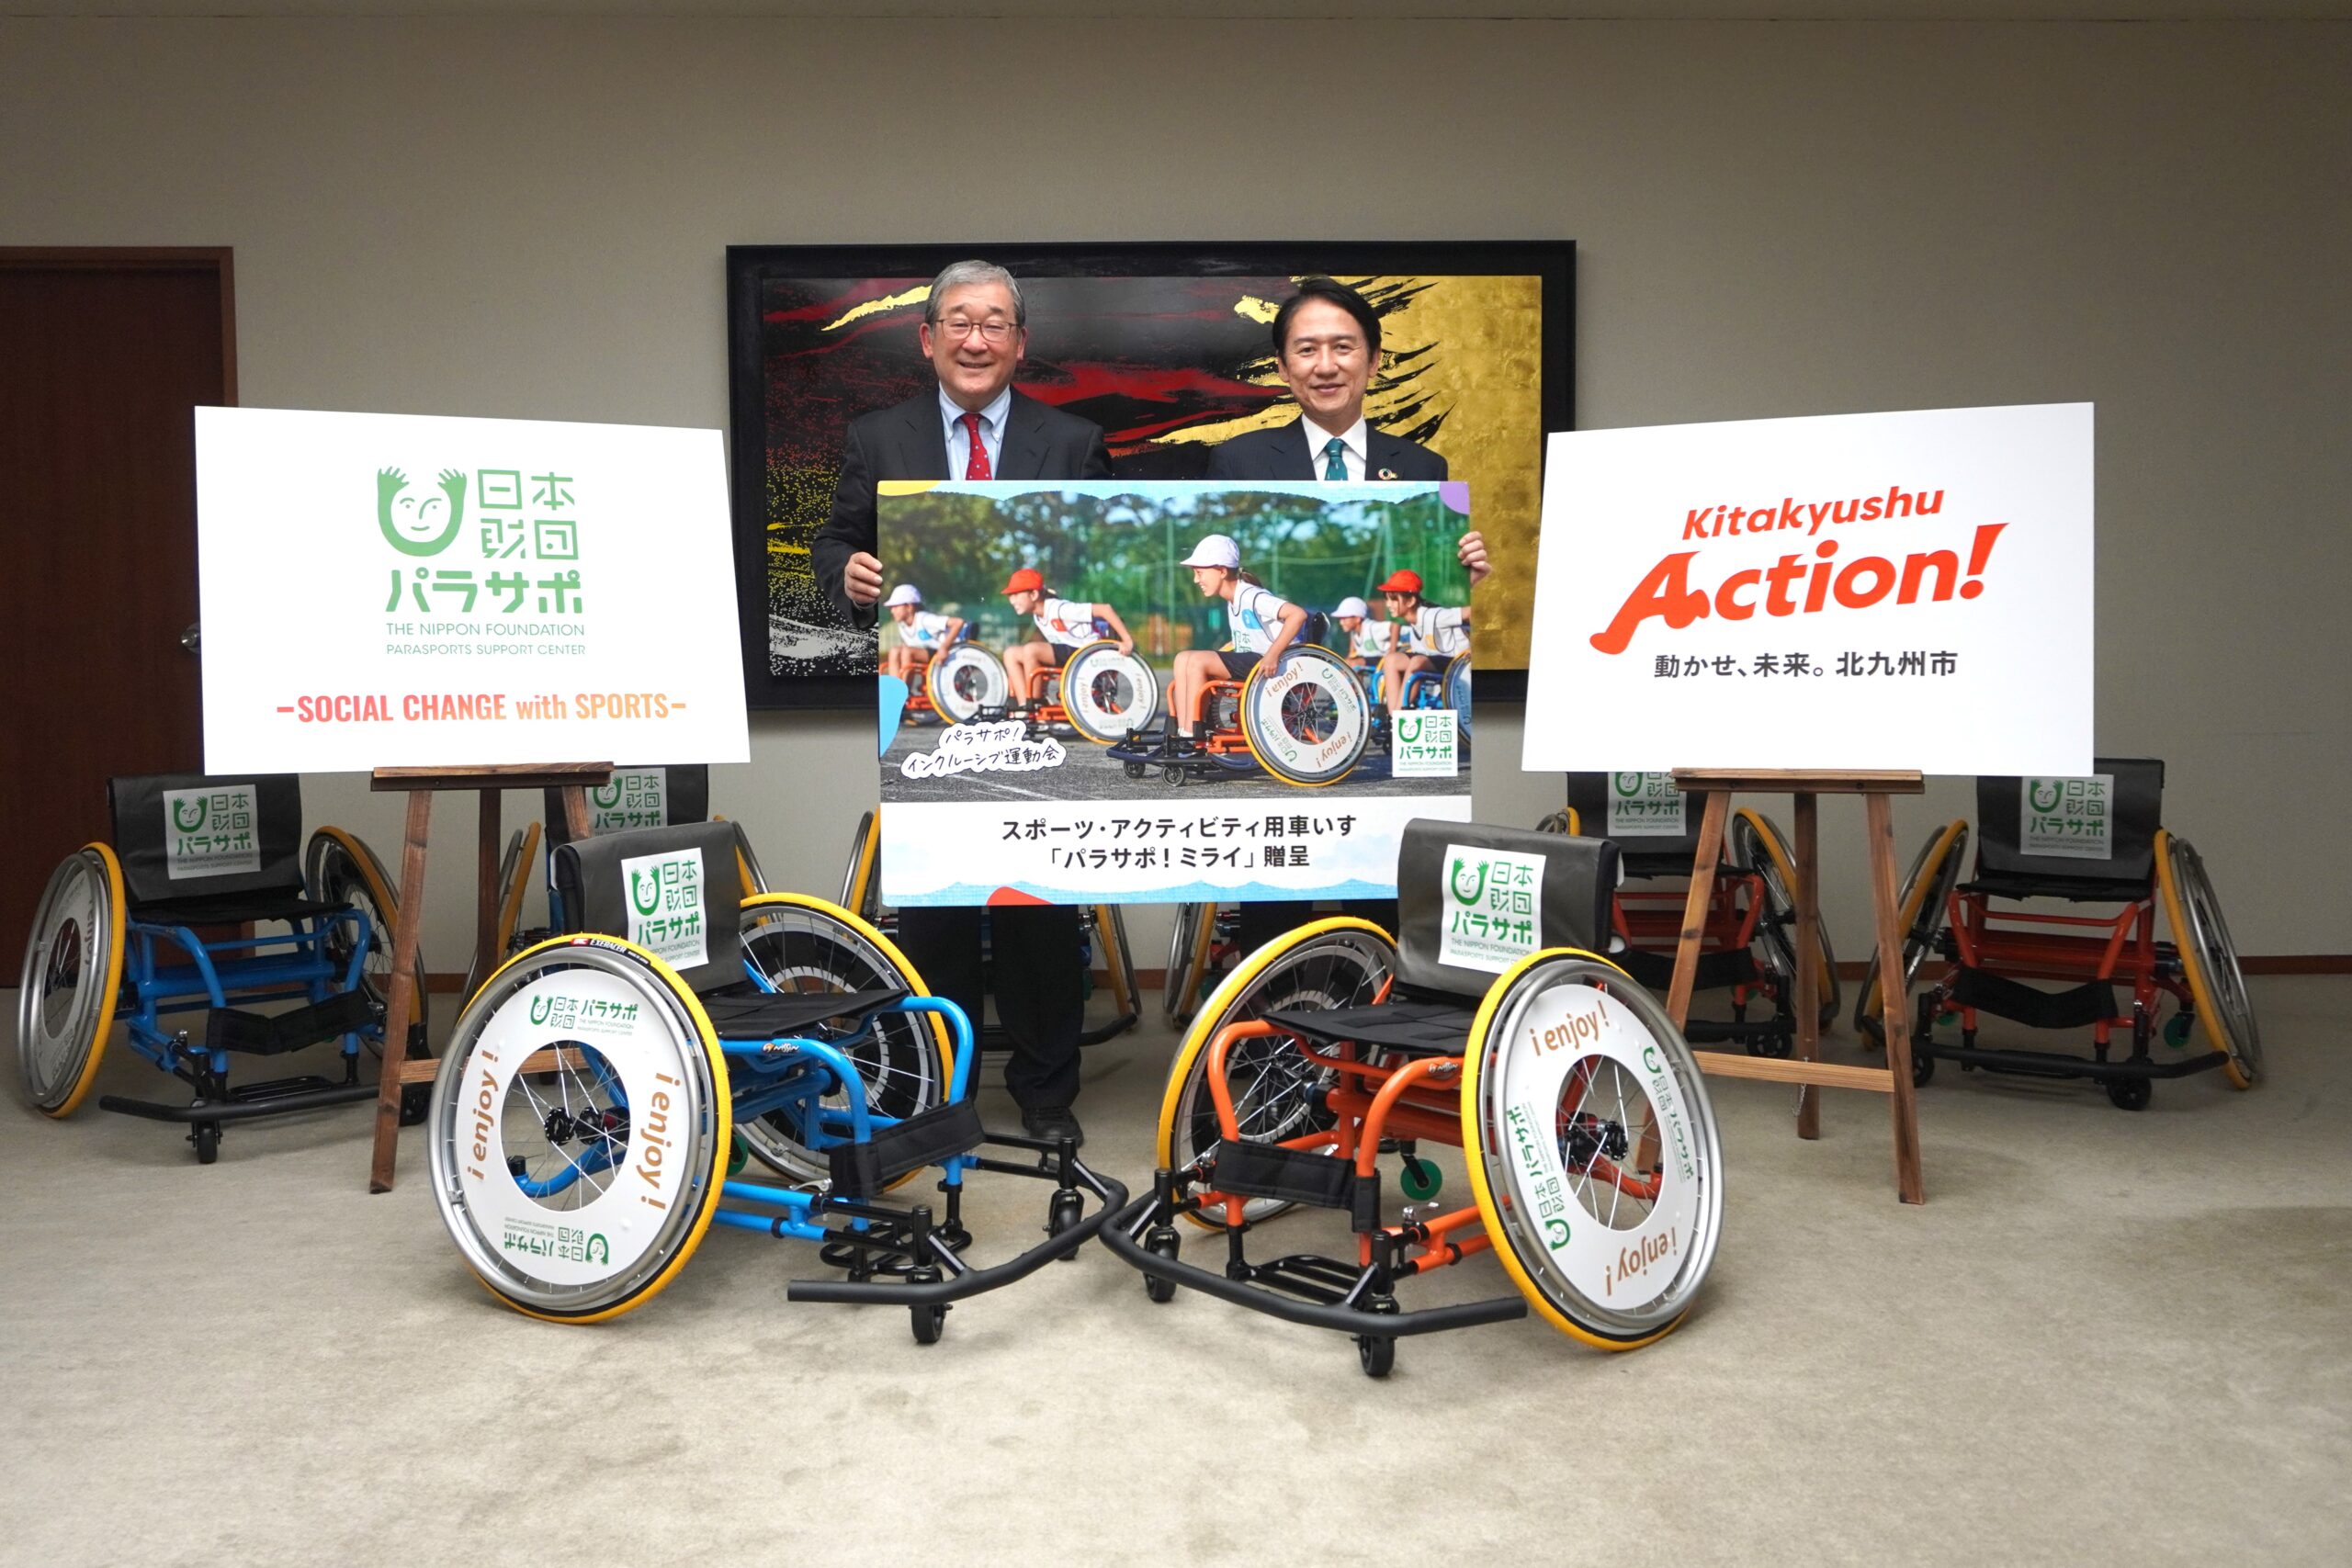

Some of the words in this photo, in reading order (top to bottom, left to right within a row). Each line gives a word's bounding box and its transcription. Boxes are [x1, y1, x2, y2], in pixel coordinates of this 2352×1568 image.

[477, 468, 576, 511] 日本
[1682, 485, 1945, 540] Kitakyushu
[481, 518, 580, 560] 財団
[385, 567, 583, 614] パラサポ
[1589, 522, 2010, 655] Action!
[386, 623, 413, 636] THE
[420, 623, 481, 636] NIPPON
[486, 623, 585, 637] FOUNDATION
[387, 644, 472, 655] PARASPORTS
[477, 644, 533, 655] SUPPORT
[537, 644, 586, 655] CENTER
[403, 694, 506, 721] CHANGE
[515, 694, 567, 719] with
[908, 744, 1059, 773] インクルーシブ運動会
[1398, 745, 1453, 759] パラサポ
[595, 810, 661, 829] パラサポ
[1615, 800, 1679, 816] パラサポ
[1001, 816, 1357, 840] スポーツ・アクティビティ用車いす
[2030, 817, 2104, 836] パラサポ
[177, 831, 252, 855] パラサポ
[662, 860, 697, 885] 日本
[1491, 861, 1533, 887] 日本
[638, 911, 700, 946] パラサポ
[1452, 910, 1532, 945] パラサポ
[581, 999, 639, 1021] パラサポ
[1507, 1105, 1544, 1177] パラサポ
[504, 1232, 554, 1257] パラサポ
